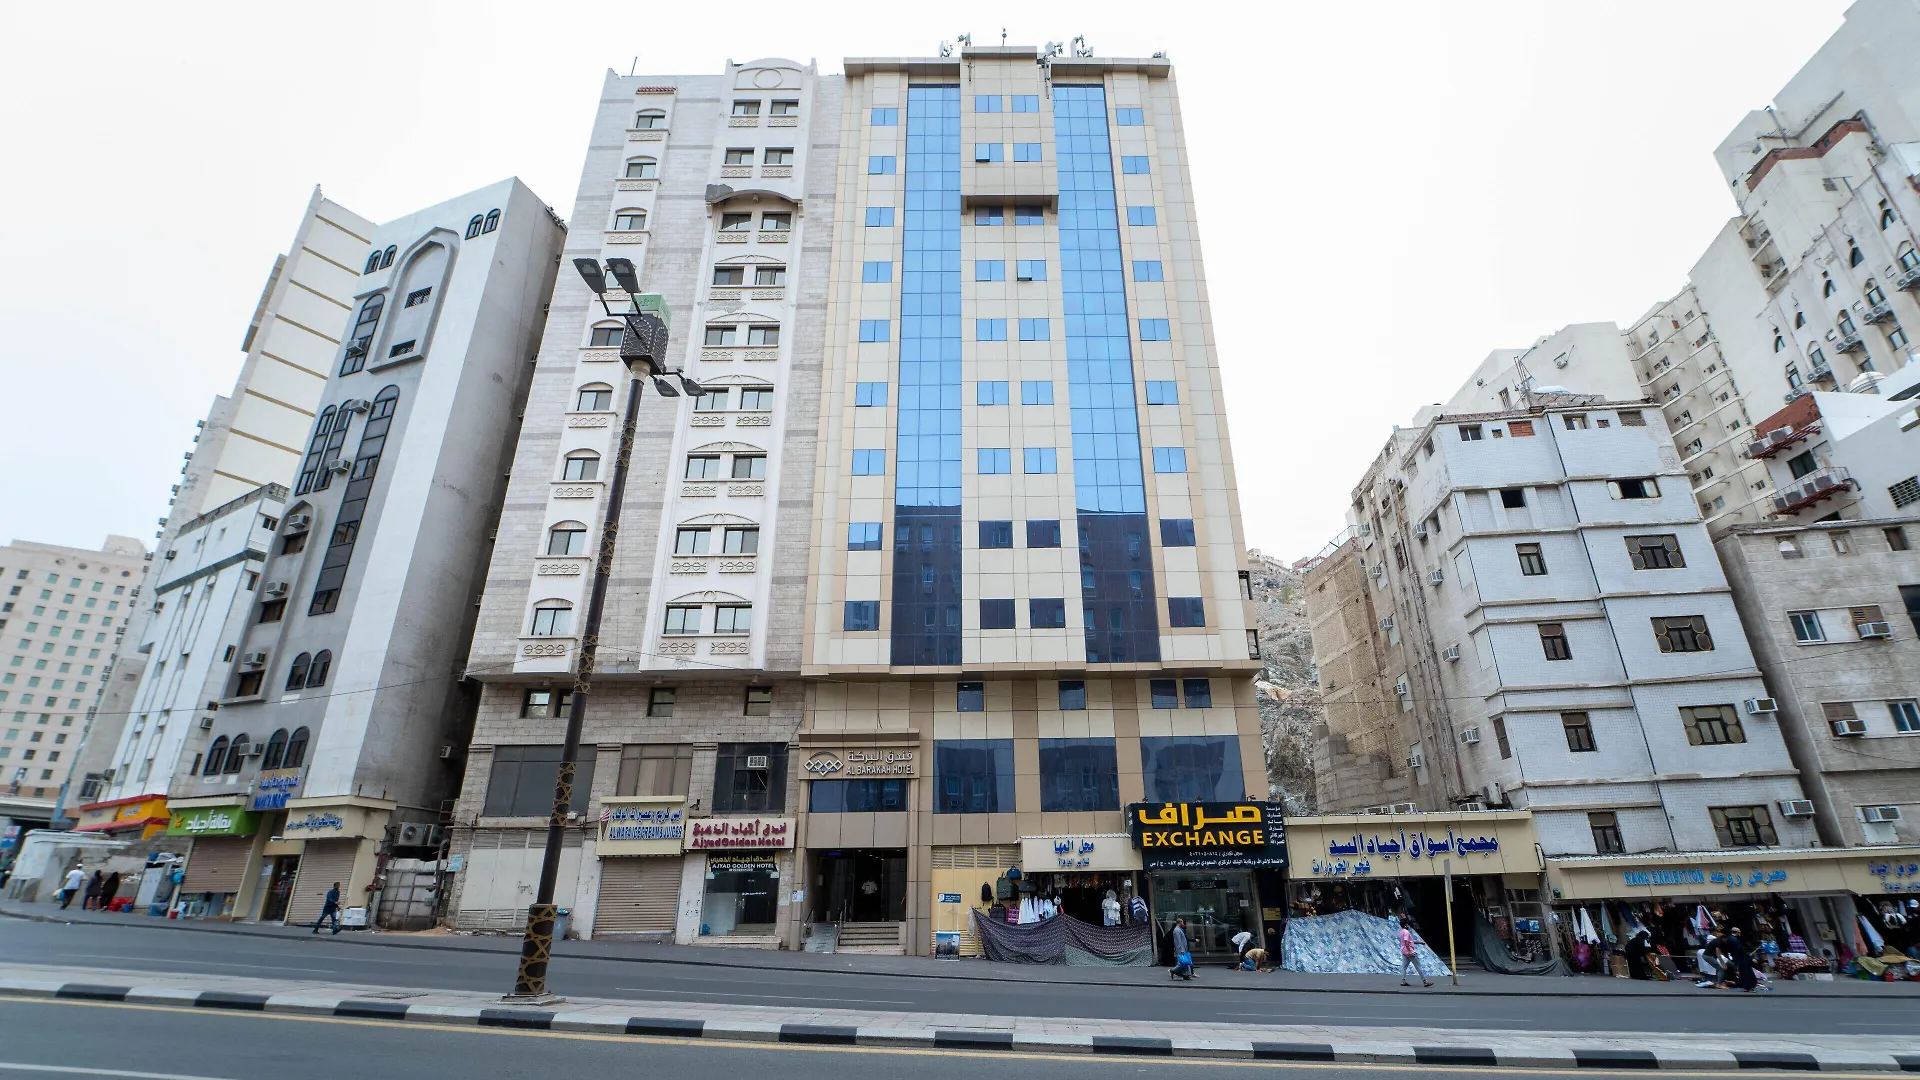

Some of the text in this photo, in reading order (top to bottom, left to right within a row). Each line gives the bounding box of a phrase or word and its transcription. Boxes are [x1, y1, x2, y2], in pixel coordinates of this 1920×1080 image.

[847, 750, 913, 765] فندق البركة
[846, 766, 855, 775] AL
[857, 765, 891, 775] BARAKAH
[892, 764, 915, 774] HOTEL
[185, 809, 233, 833] بقالة أجياد
[1138, 802, 1262, 831] صراف
[692, 819, 787, 837] فندق أجياد الذهبي
[692, 837, 785, 848] Ajyad Golden Hotel
[1142, 830, 1265, 847] EXCHANGE
[1328, 825, 1499, 860] مجمع أسواق أجياد السد
[1053, 839, 1095, 856] محل المها
[1352, 856, 1371, 877] فجر
[1651, 869, 1705, 885] EXHIBITION
[1748, 867, 1788, 887] معرض
